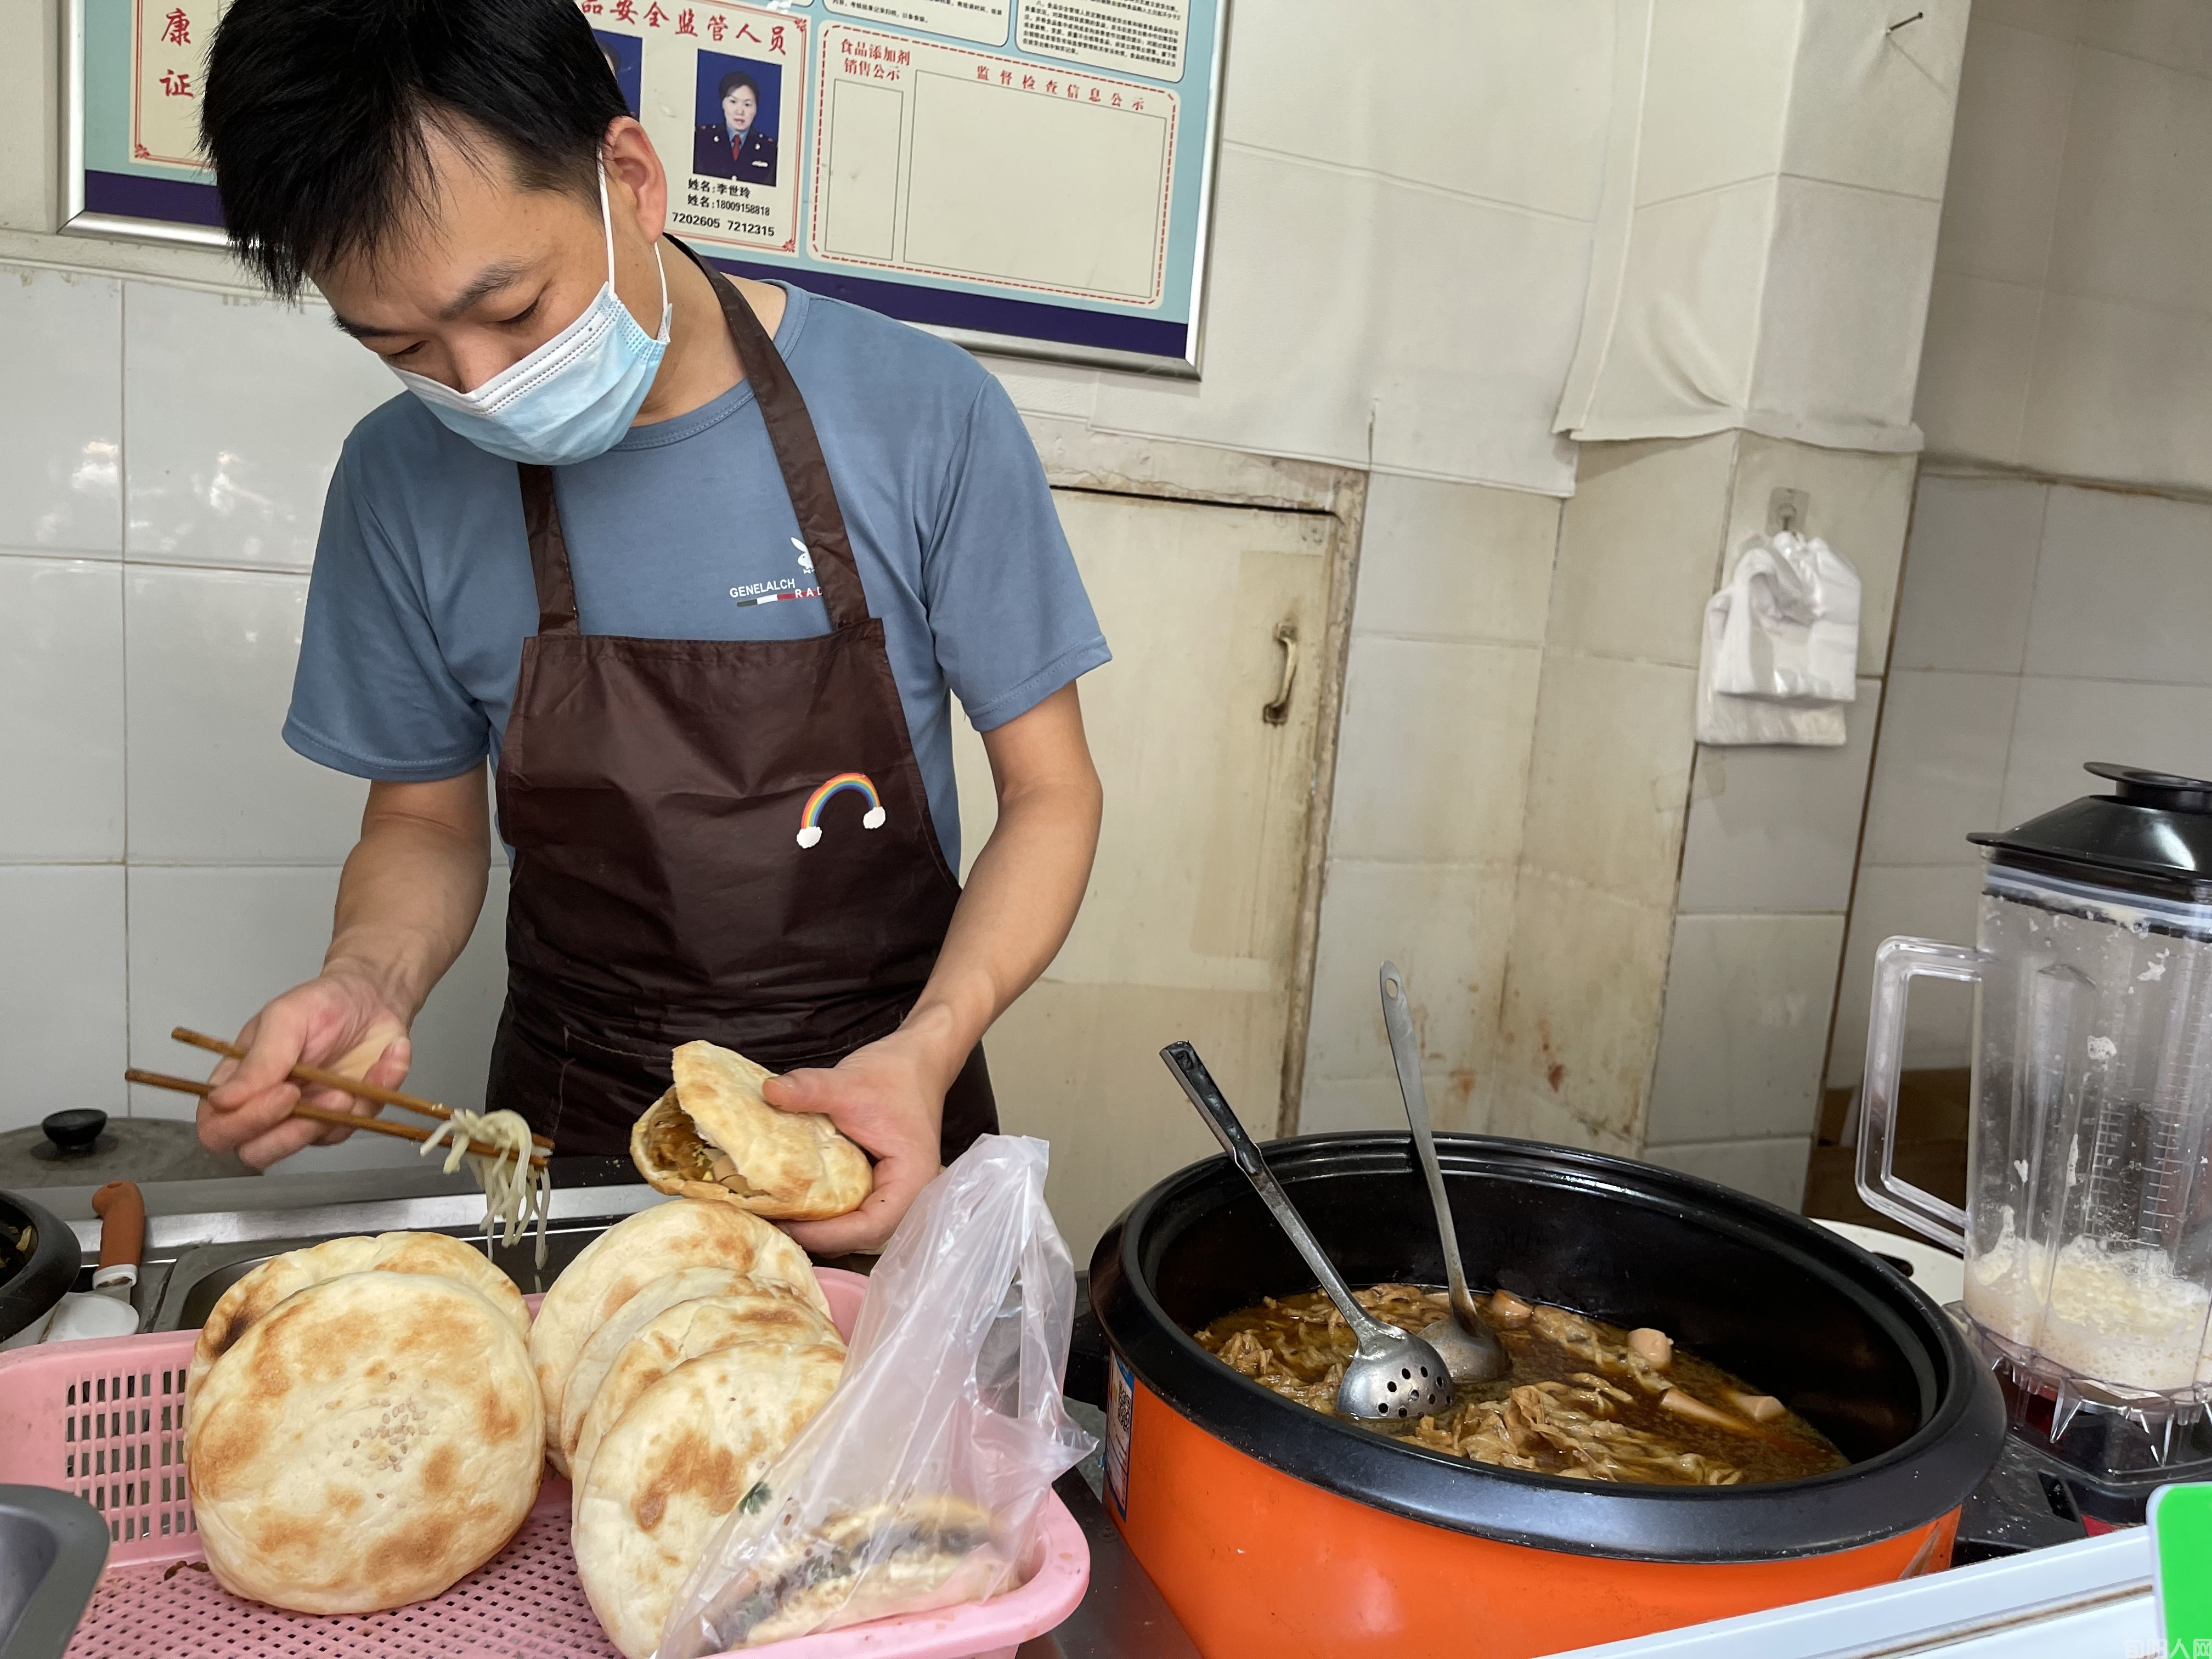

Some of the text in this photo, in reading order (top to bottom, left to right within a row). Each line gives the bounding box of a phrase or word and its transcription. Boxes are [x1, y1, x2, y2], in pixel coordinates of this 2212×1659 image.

[841, 38, 910, 66] 食品添加剂
[844, 58, 900, 81] 销售公示
[977, 65, 1144, 111] 监督检查信息公示
[672, 212, 775, 236] 7202605 7212315
[730, 578, 795, 598] GENELALCH
